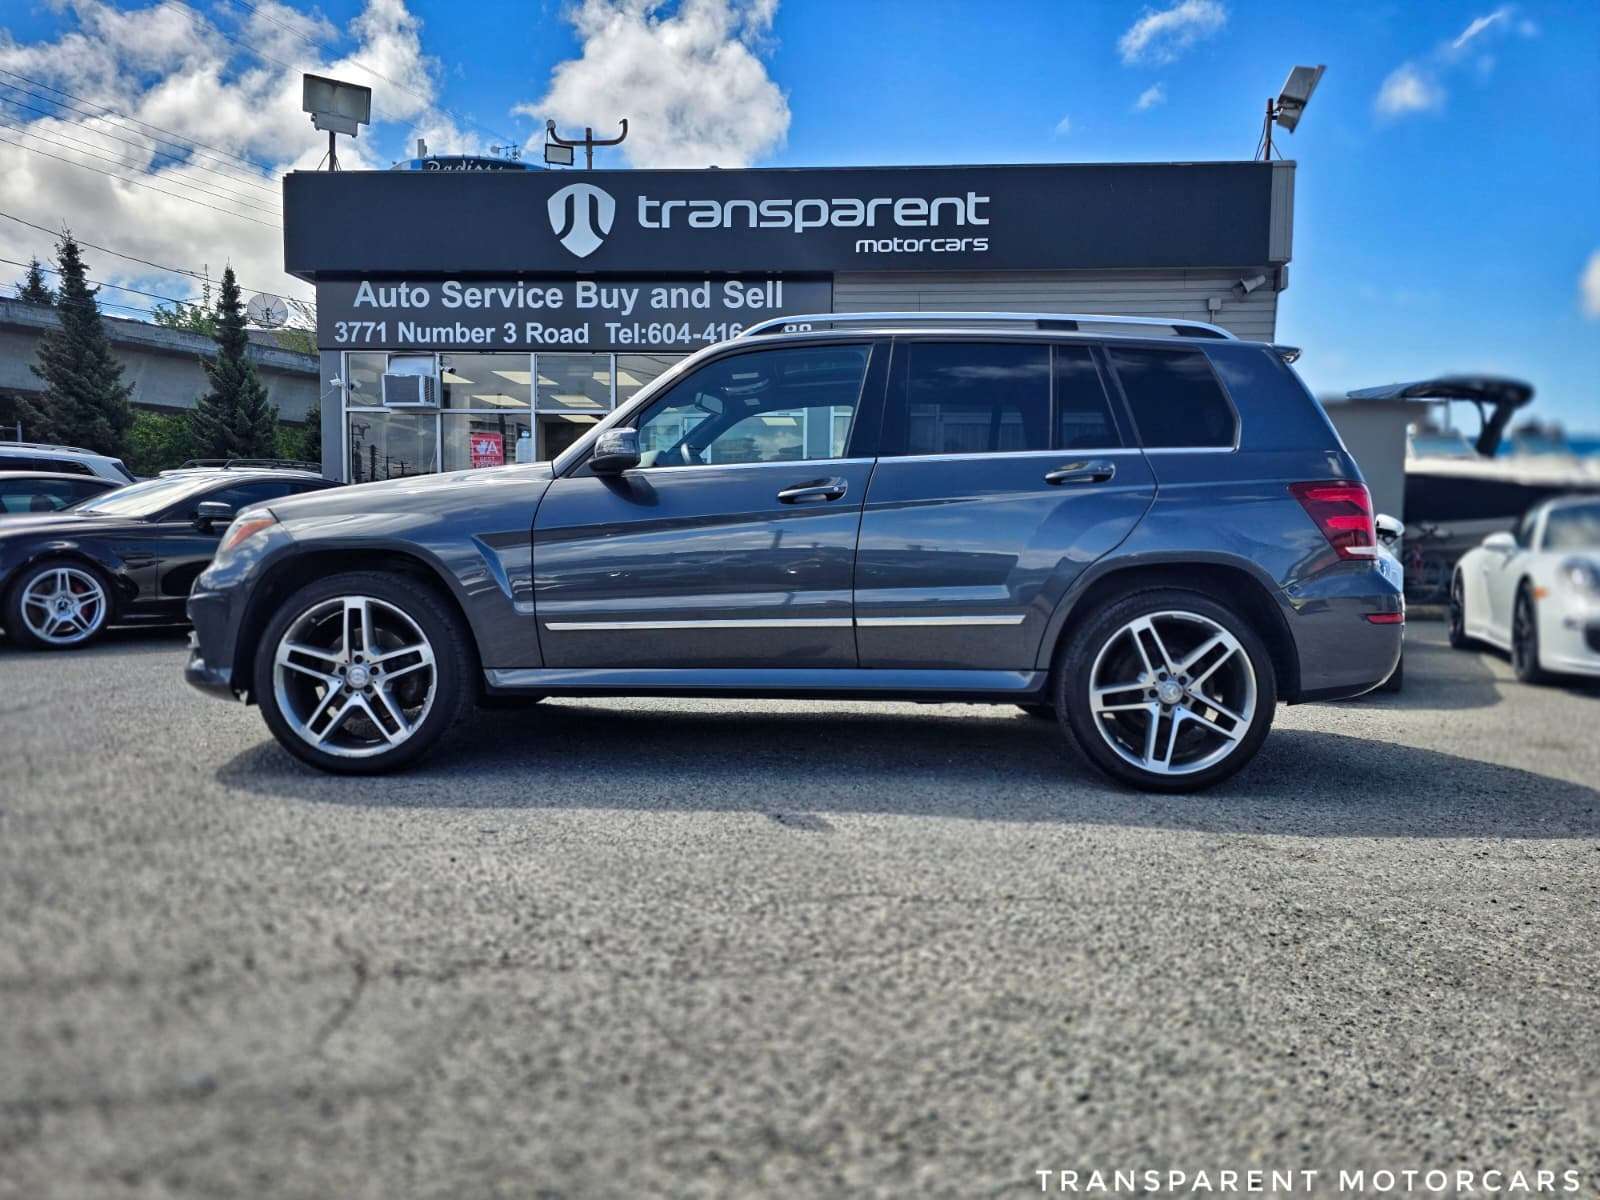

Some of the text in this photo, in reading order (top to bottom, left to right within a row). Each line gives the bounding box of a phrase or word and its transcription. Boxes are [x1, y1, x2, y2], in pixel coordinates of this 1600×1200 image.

[638, 191, 990, 233] transparent
[855, 237, 989, 253] motorcars
[353, 280, 783, 316] Auto Service Buy and Sell
[334, 321, 387, 343] 3771
[398, 322, 496, 344] Number
[503, 322, 517, 344] 3
[526, 322, 589, 344] Road
